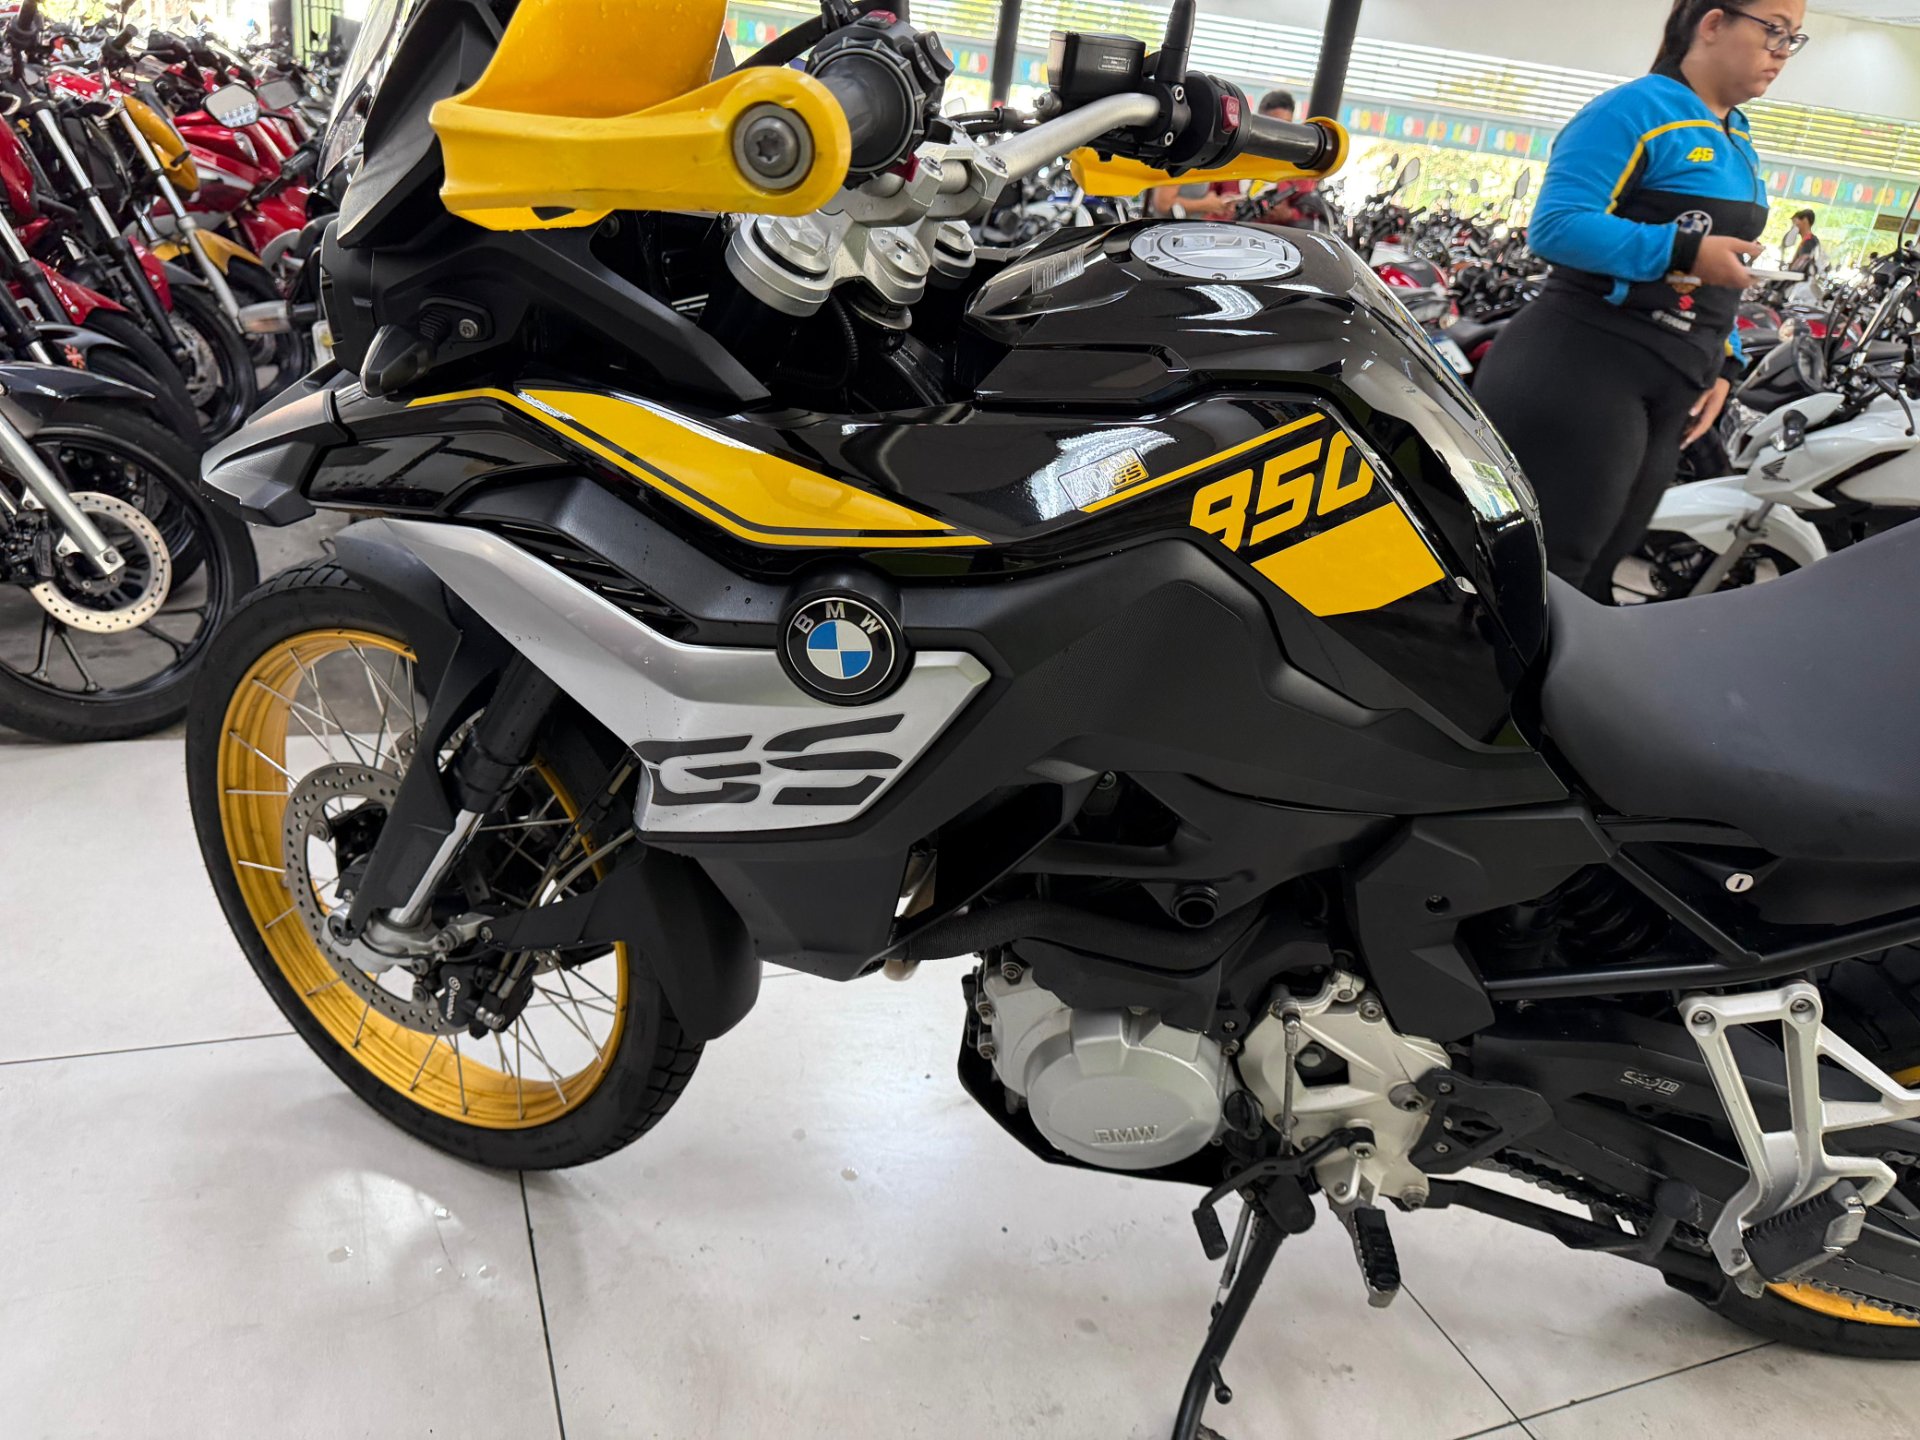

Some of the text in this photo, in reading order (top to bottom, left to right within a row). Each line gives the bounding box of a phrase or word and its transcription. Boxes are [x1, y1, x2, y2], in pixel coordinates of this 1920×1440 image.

[1686, 146, 1715, 163] 46
[794, 602, 882, 634] BMW
[632, 713, 905, 807] GS
[1093, 1125, 1159, 1144] BMW
